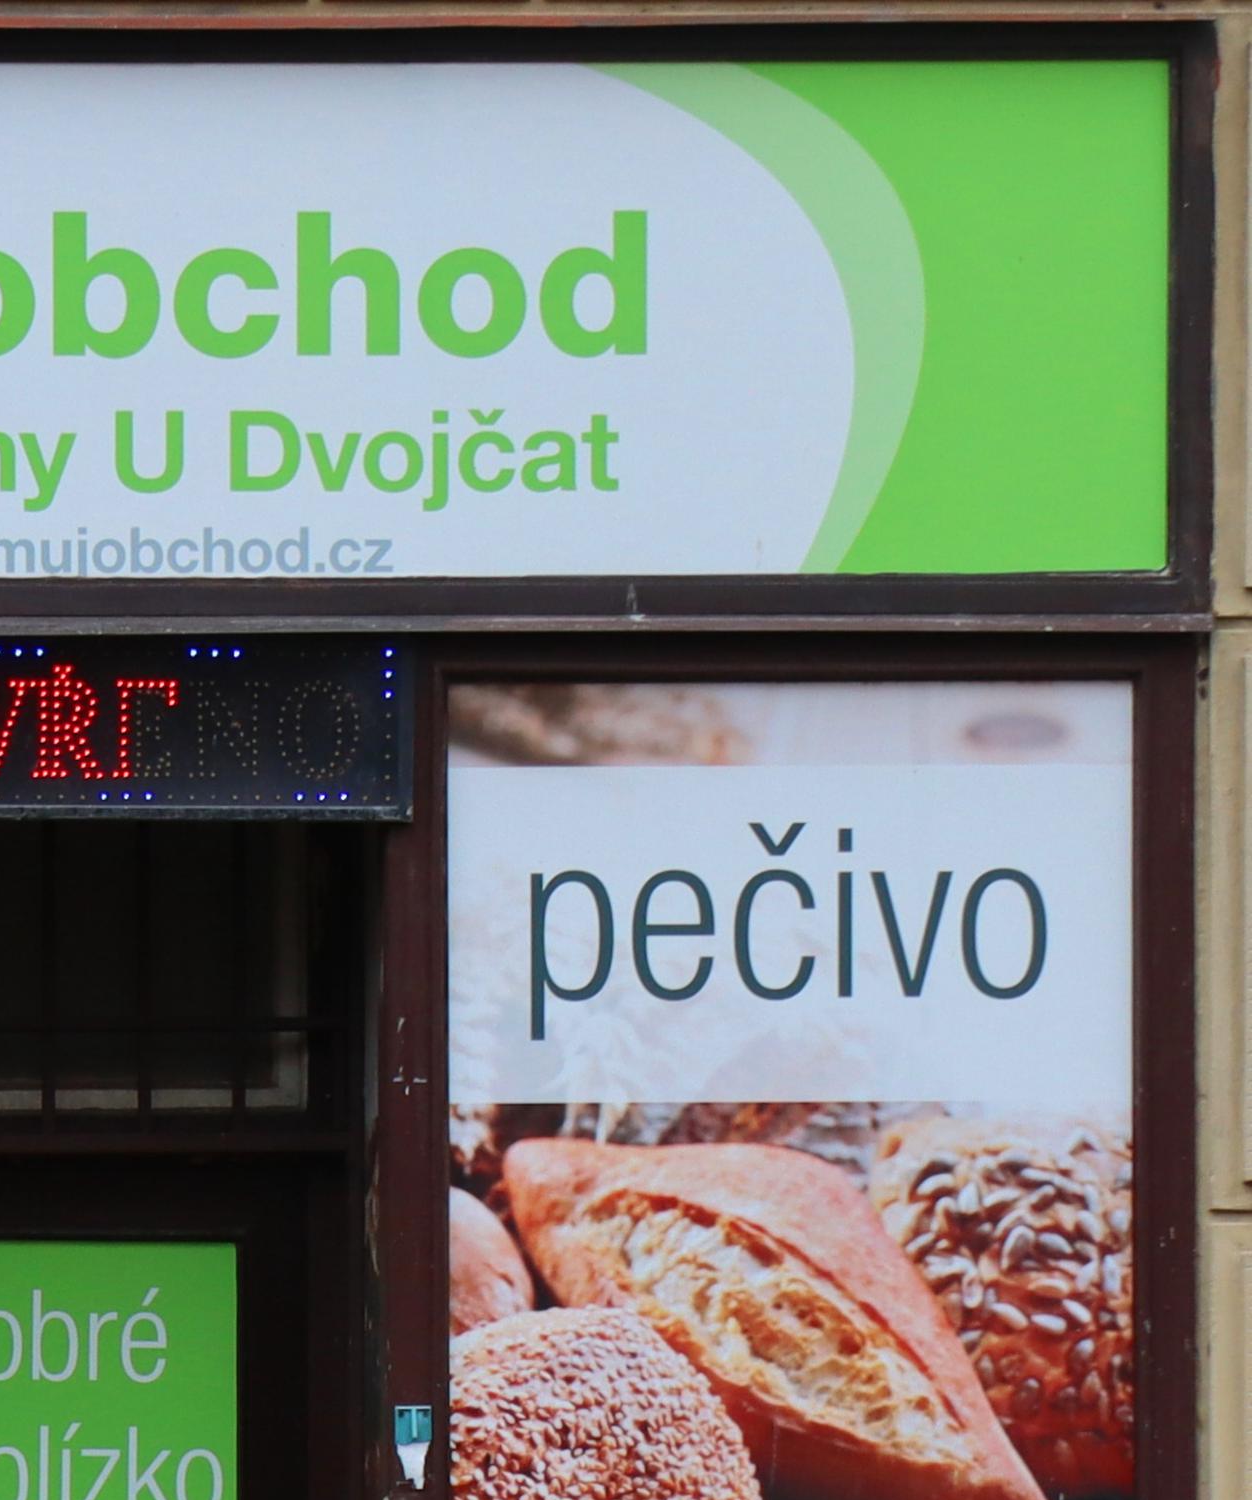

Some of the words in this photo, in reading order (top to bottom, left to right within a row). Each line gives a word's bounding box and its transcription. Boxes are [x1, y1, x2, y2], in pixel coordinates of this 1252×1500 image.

[115, 412, 184, 493] U
[230, 408, 620, 509] Dvojčat
[529, 821, 1048, 1041] pečivo
